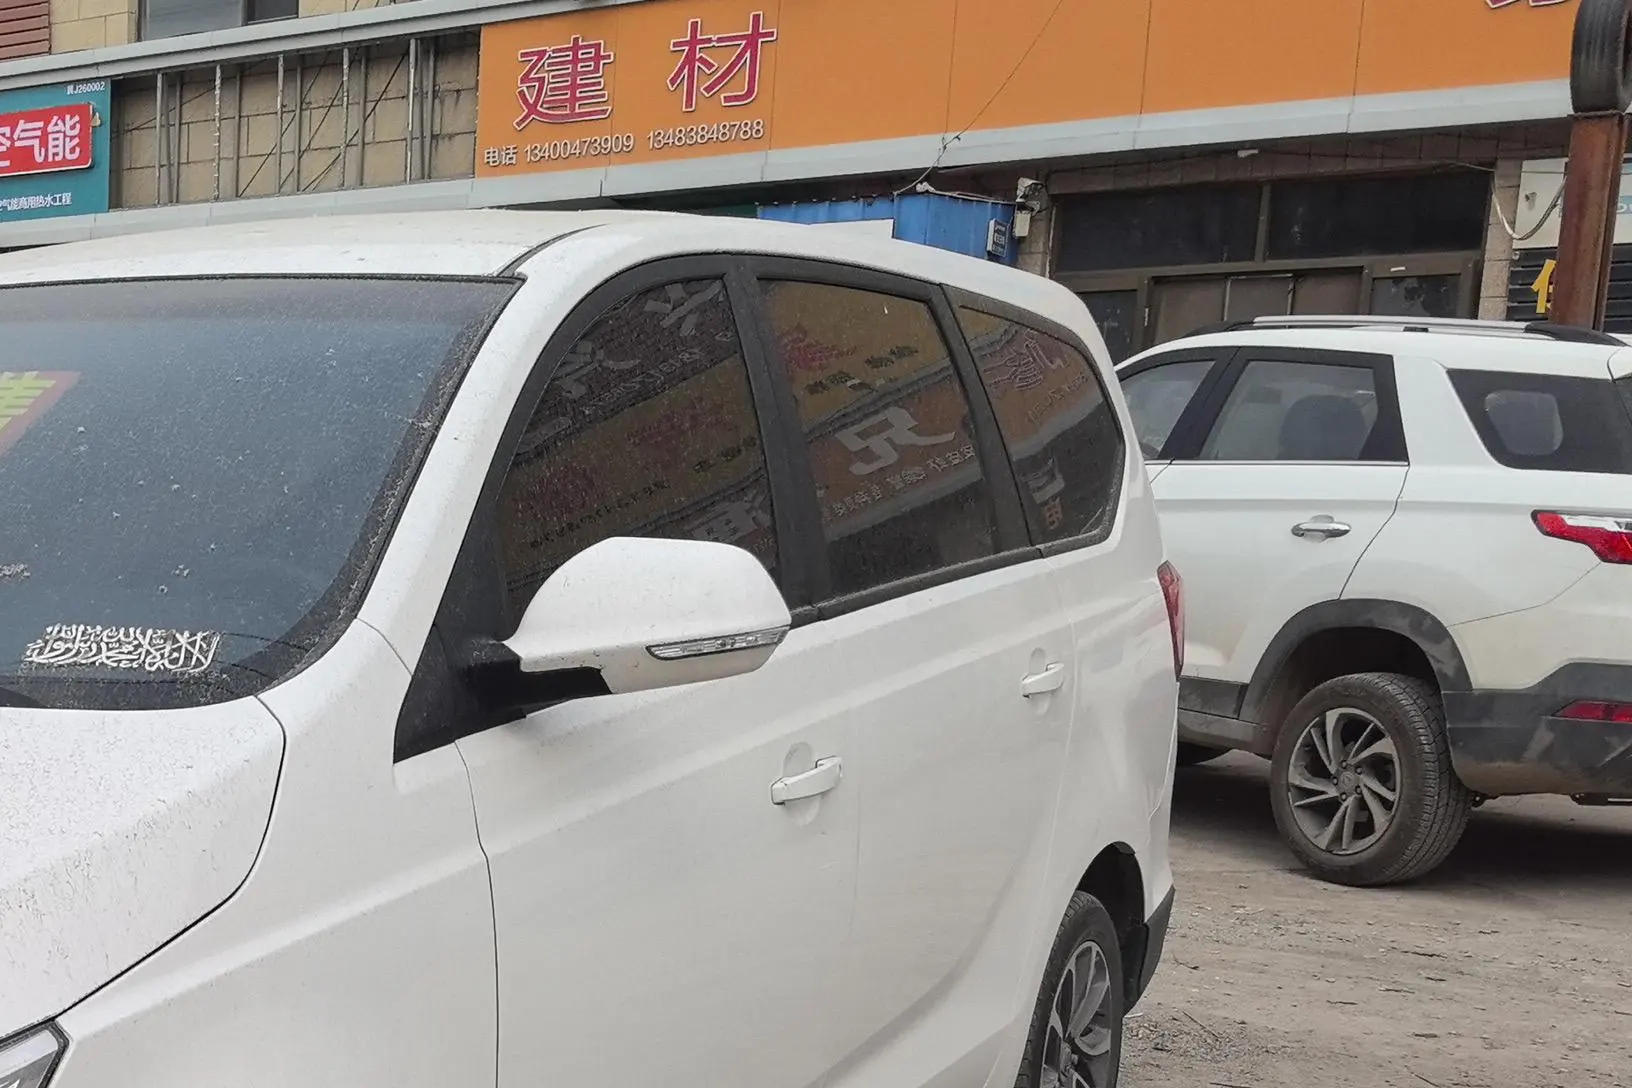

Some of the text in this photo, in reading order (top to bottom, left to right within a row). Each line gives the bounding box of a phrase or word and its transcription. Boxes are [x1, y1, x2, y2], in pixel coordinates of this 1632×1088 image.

[512, 11, 778, 131] 建材
[483, 118, 764, 167] 电话 13400473909 13483848788
